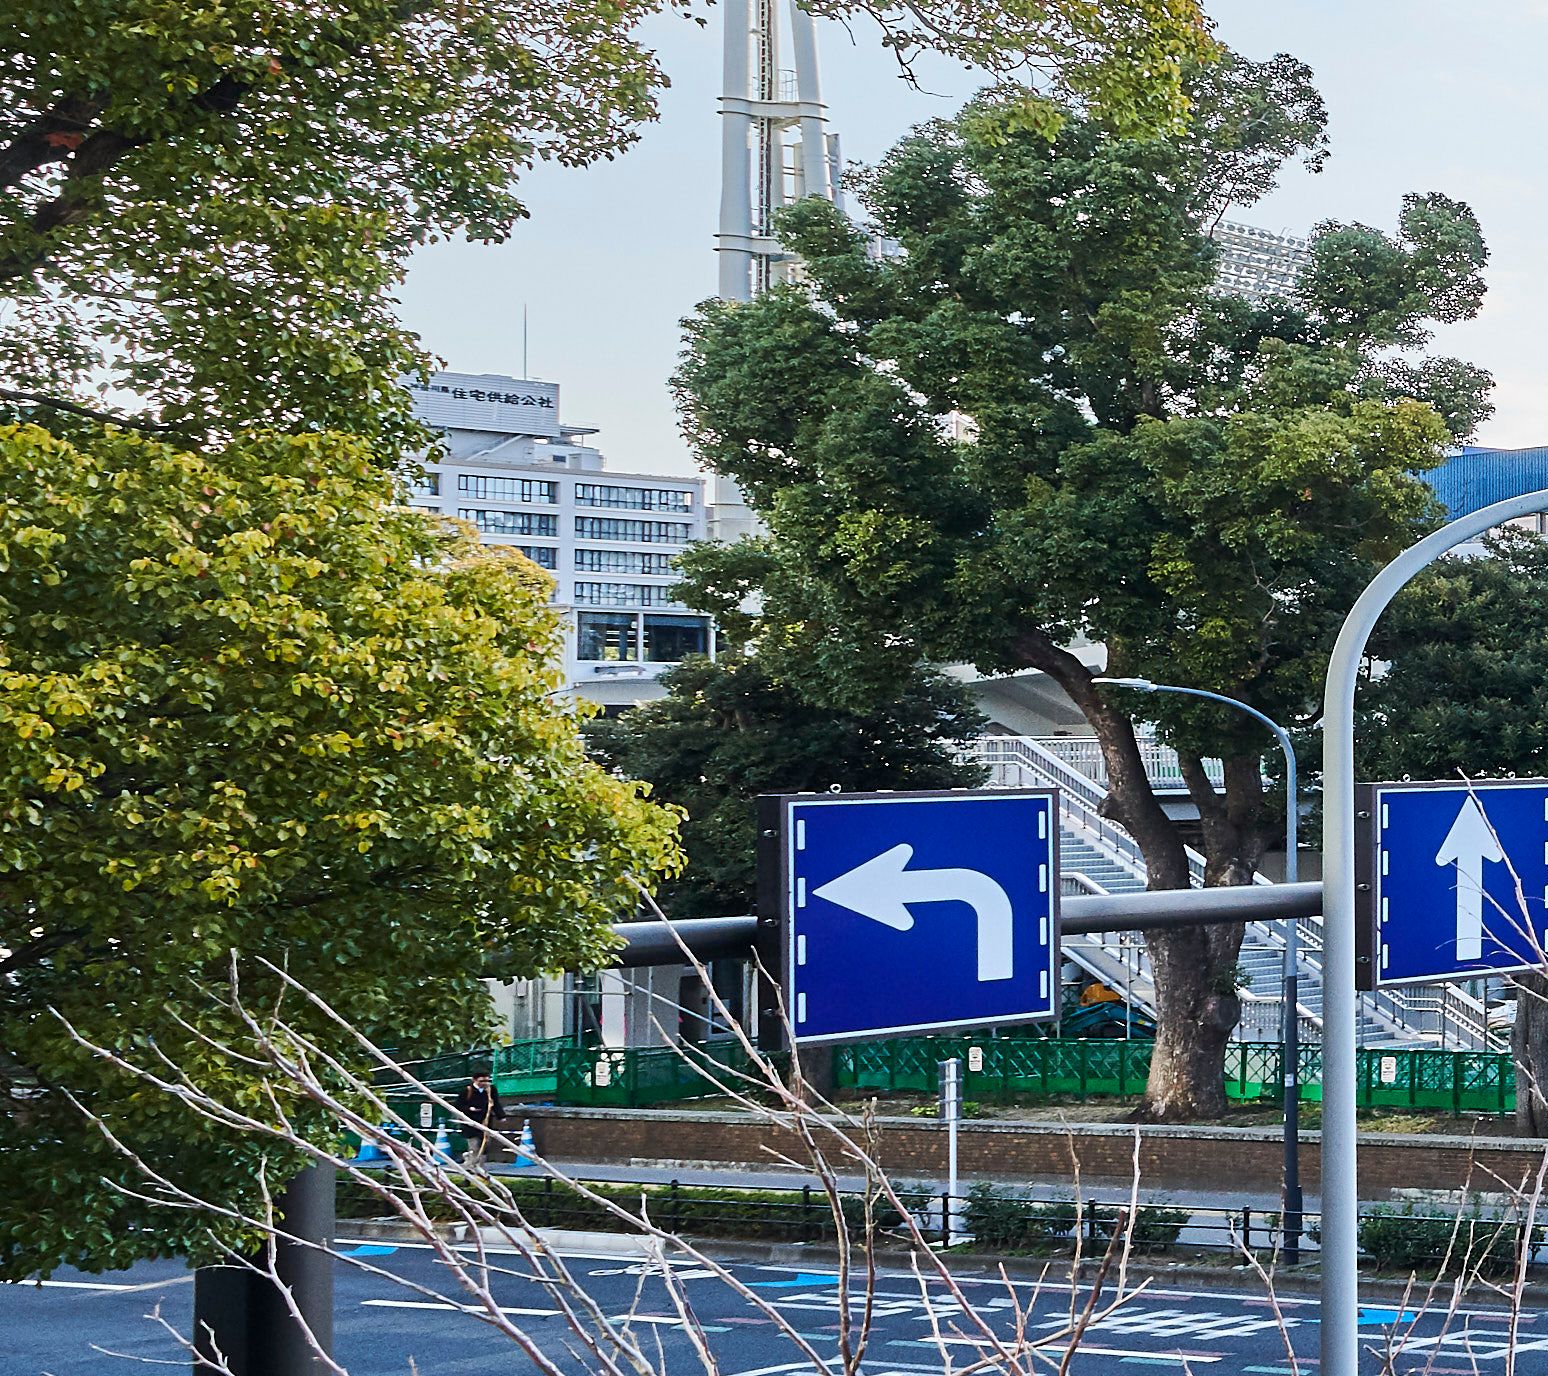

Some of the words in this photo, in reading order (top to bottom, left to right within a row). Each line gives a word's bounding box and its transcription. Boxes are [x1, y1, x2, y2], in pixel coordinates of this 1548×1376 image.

[451, 387, 554, 408] 住宅供給公社
